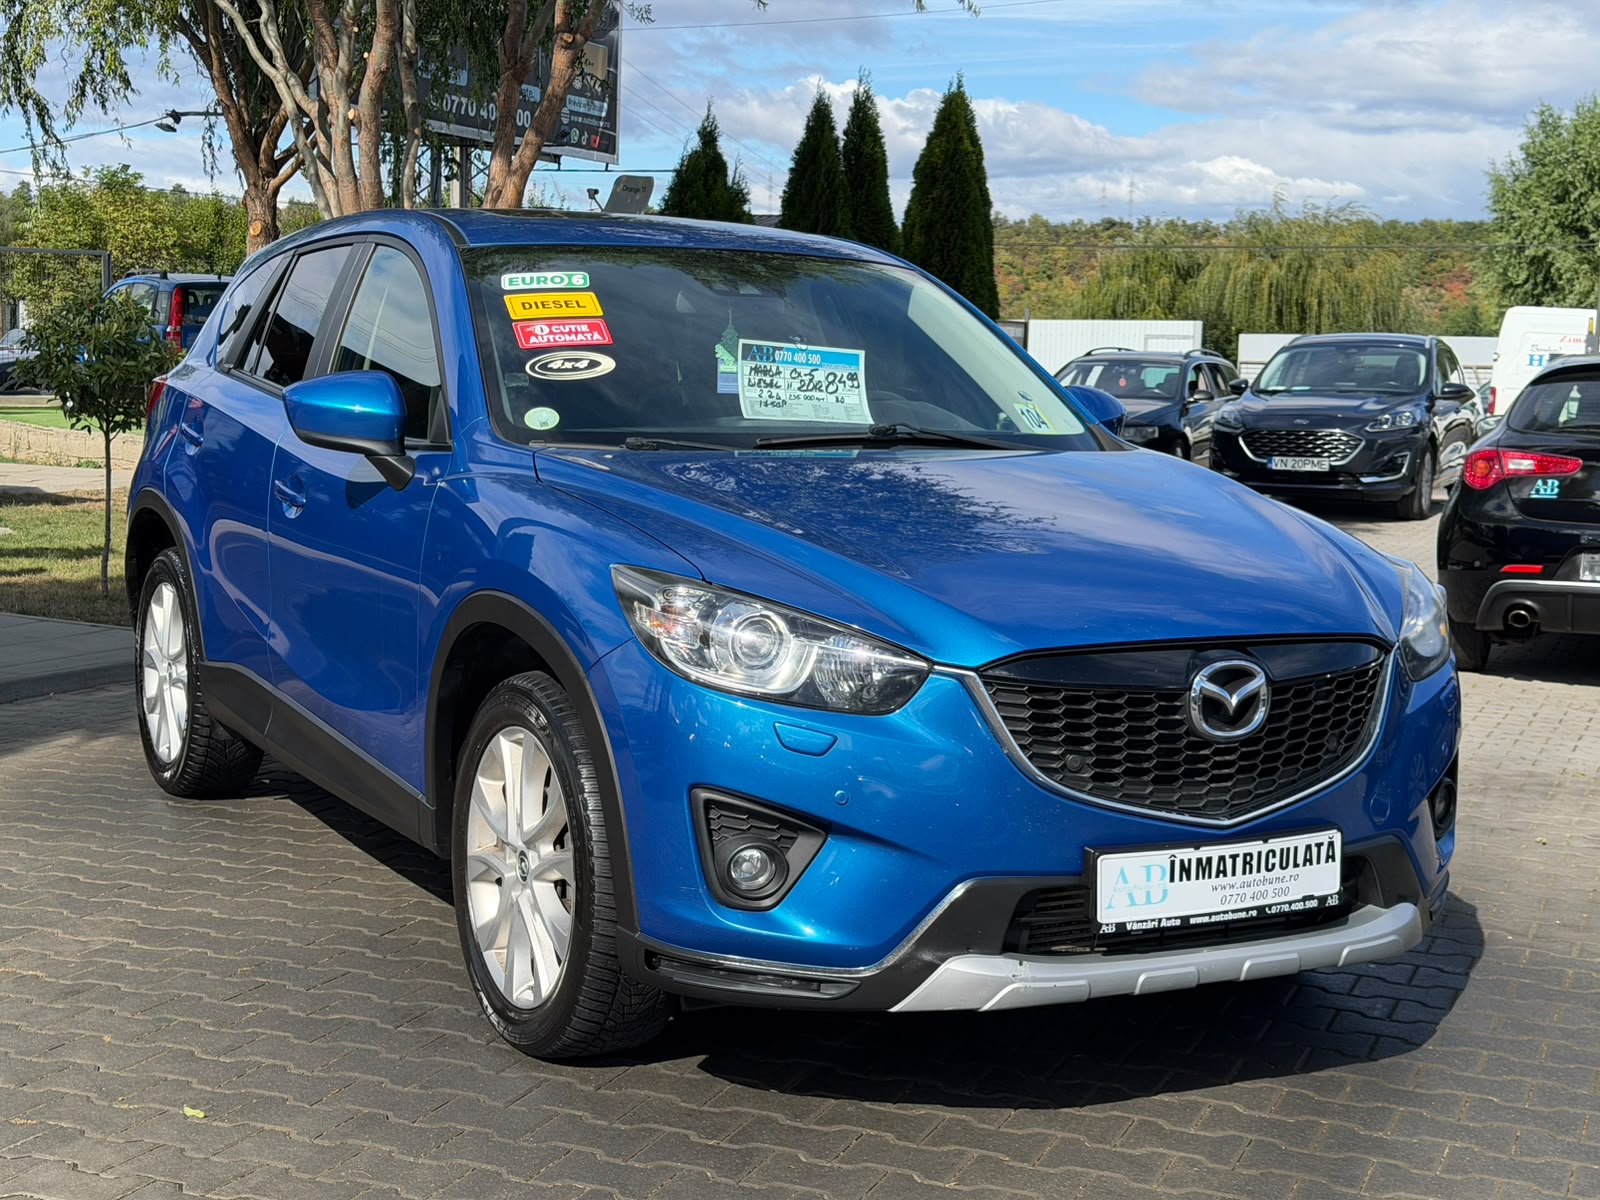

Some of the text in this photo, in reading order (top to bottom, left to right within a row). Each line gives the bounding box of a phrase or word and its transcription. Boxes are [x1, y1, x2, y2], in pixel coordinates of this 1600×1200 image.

[443, 94, 476, 117] 0770
[508, 274, 585, 286] EURO 6
[521, 300, 587, 310] DIESEL
[529, 331, 603, 344] AUTOMATĂ
[551, 324, 590, 333] CUTIE
[1560, 335, 1586, 344] Zim
[747, 344, 821, 365] AB 0770 400 500
[547, 359, 590, 370] 4x4
[825, 372, 860, 394] 8499
[1020, 408, 1049, 429] 104
[1273, 458, 1328, 470] VN 20PME
[1530, 478, 1560, 495] AB
[1105, 835, 1336, 910] AB ÎNMATRICULATĂ
[1211, 873, 1299, 893] www.autobune.ro
[1220, 886, 1290, 906] 0770 400 500
[1126, 918, 1159, 931] Vânzări
[1160, 916, 1181, 928] Auto
[1190, 909, 1258, 924] www.autobune.ro
[1271, 899, 1318, 914] 0770.400.500
[1325, 894, 1339, 907] AB
